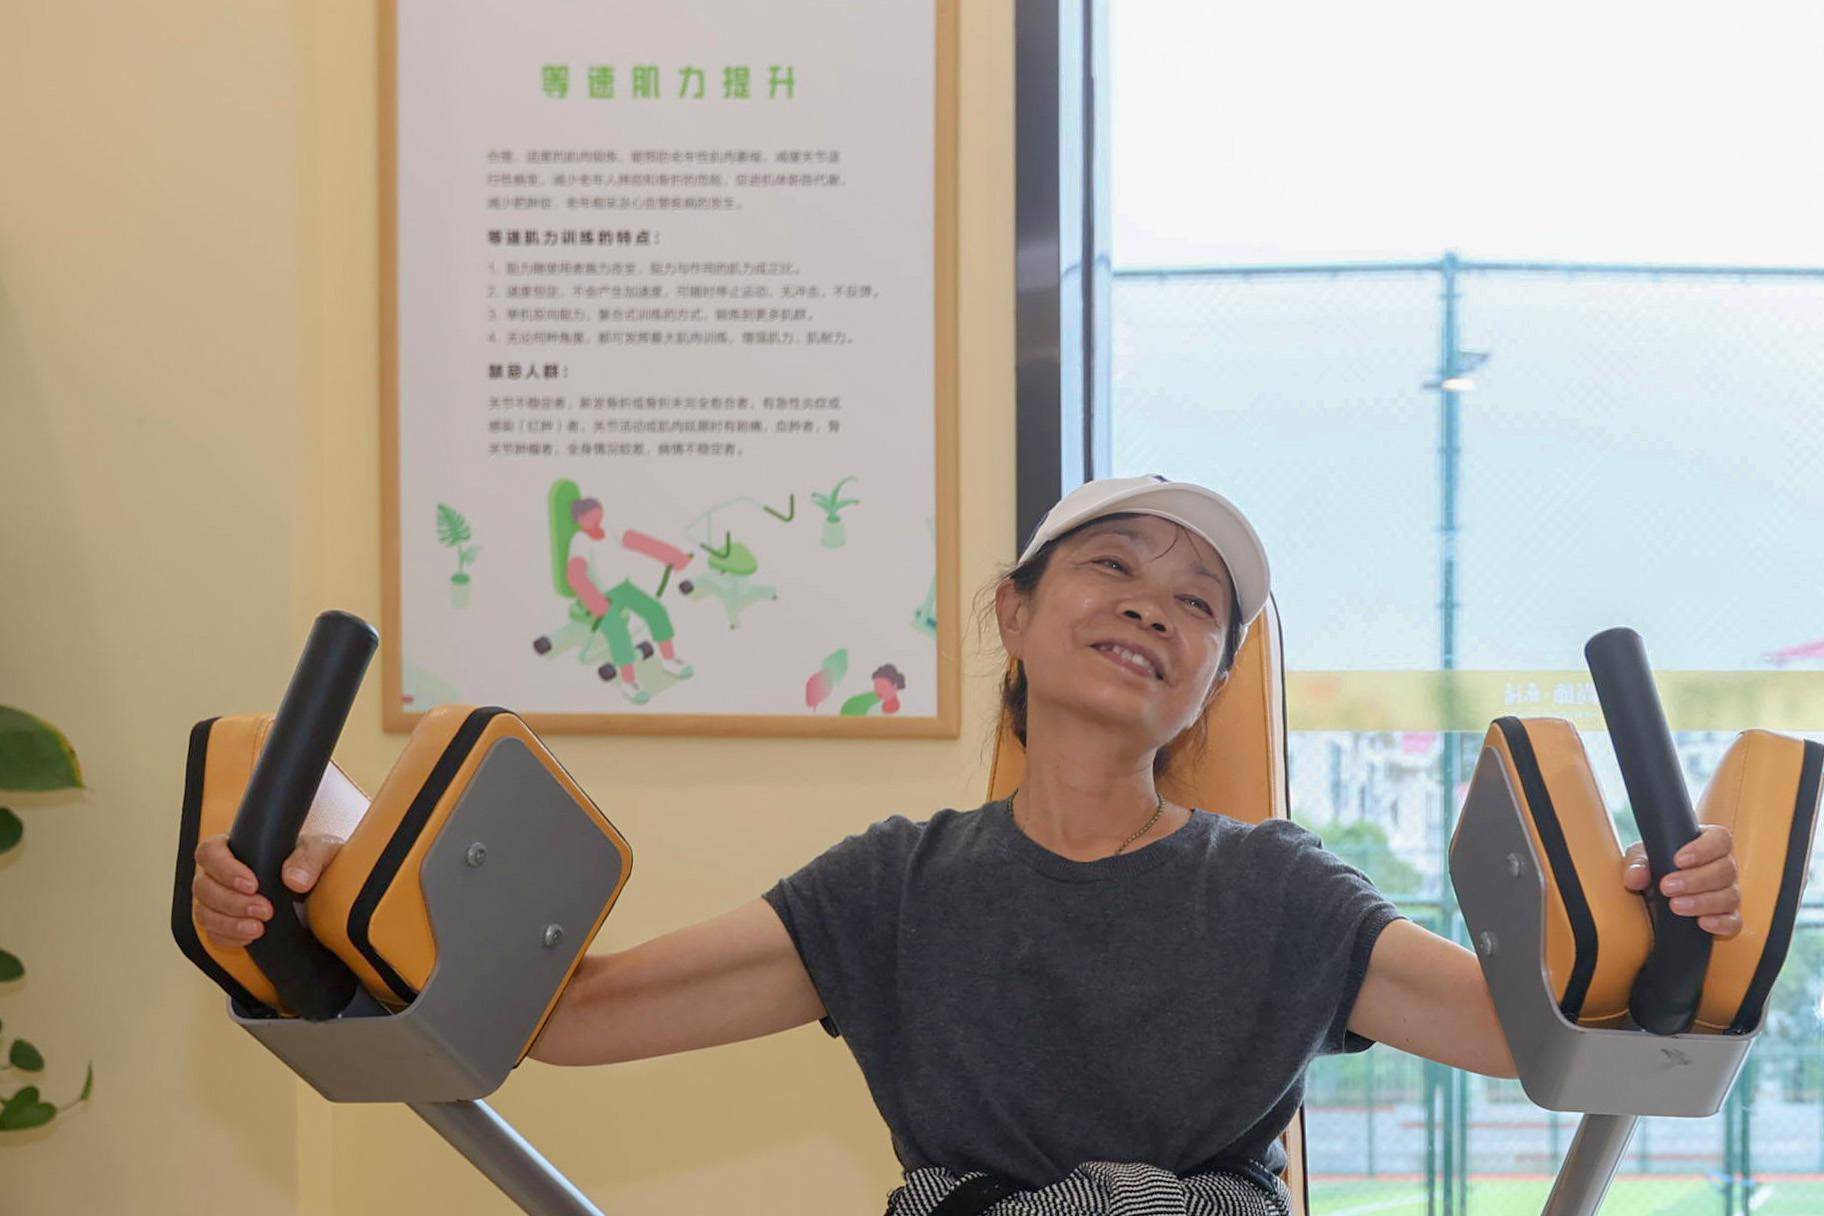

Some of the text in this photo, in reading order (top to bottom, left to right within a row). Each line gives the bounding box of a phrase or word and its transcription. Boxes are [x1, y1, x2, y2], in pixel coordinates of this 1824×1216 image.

[540, 64, 797, 99] 等速肌力提升
